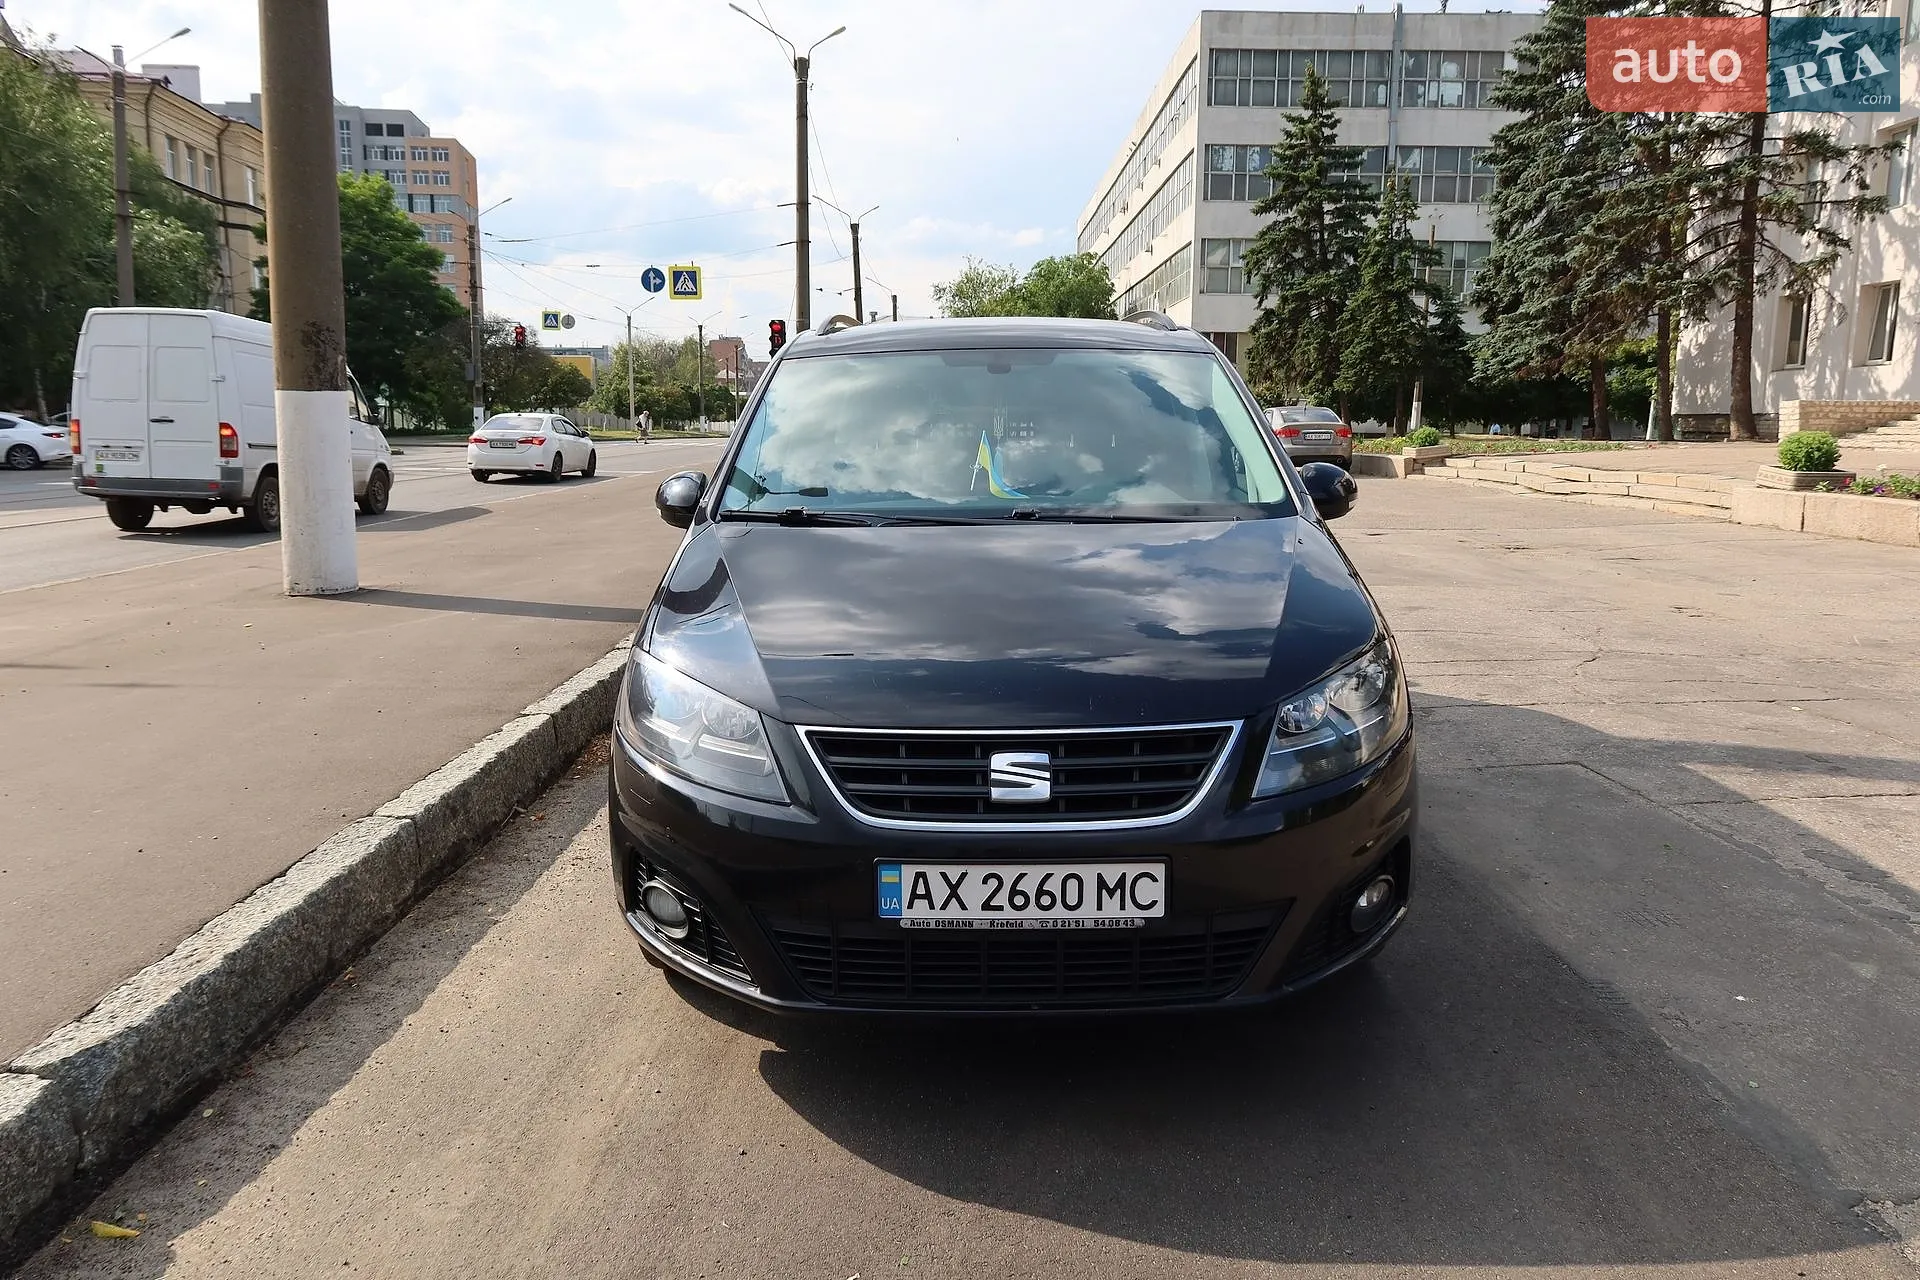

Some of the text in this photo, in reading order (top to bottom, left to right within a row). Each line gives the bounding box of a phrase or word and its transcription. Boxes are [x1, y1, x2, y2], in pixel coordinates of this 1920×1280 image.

[907, 871, 1159, 911] AX 2660 MC
[881, 898, 900, 909] UA
[910, 920, 931, 928] Auto
[935, 920, 974, 928] OSMANN
